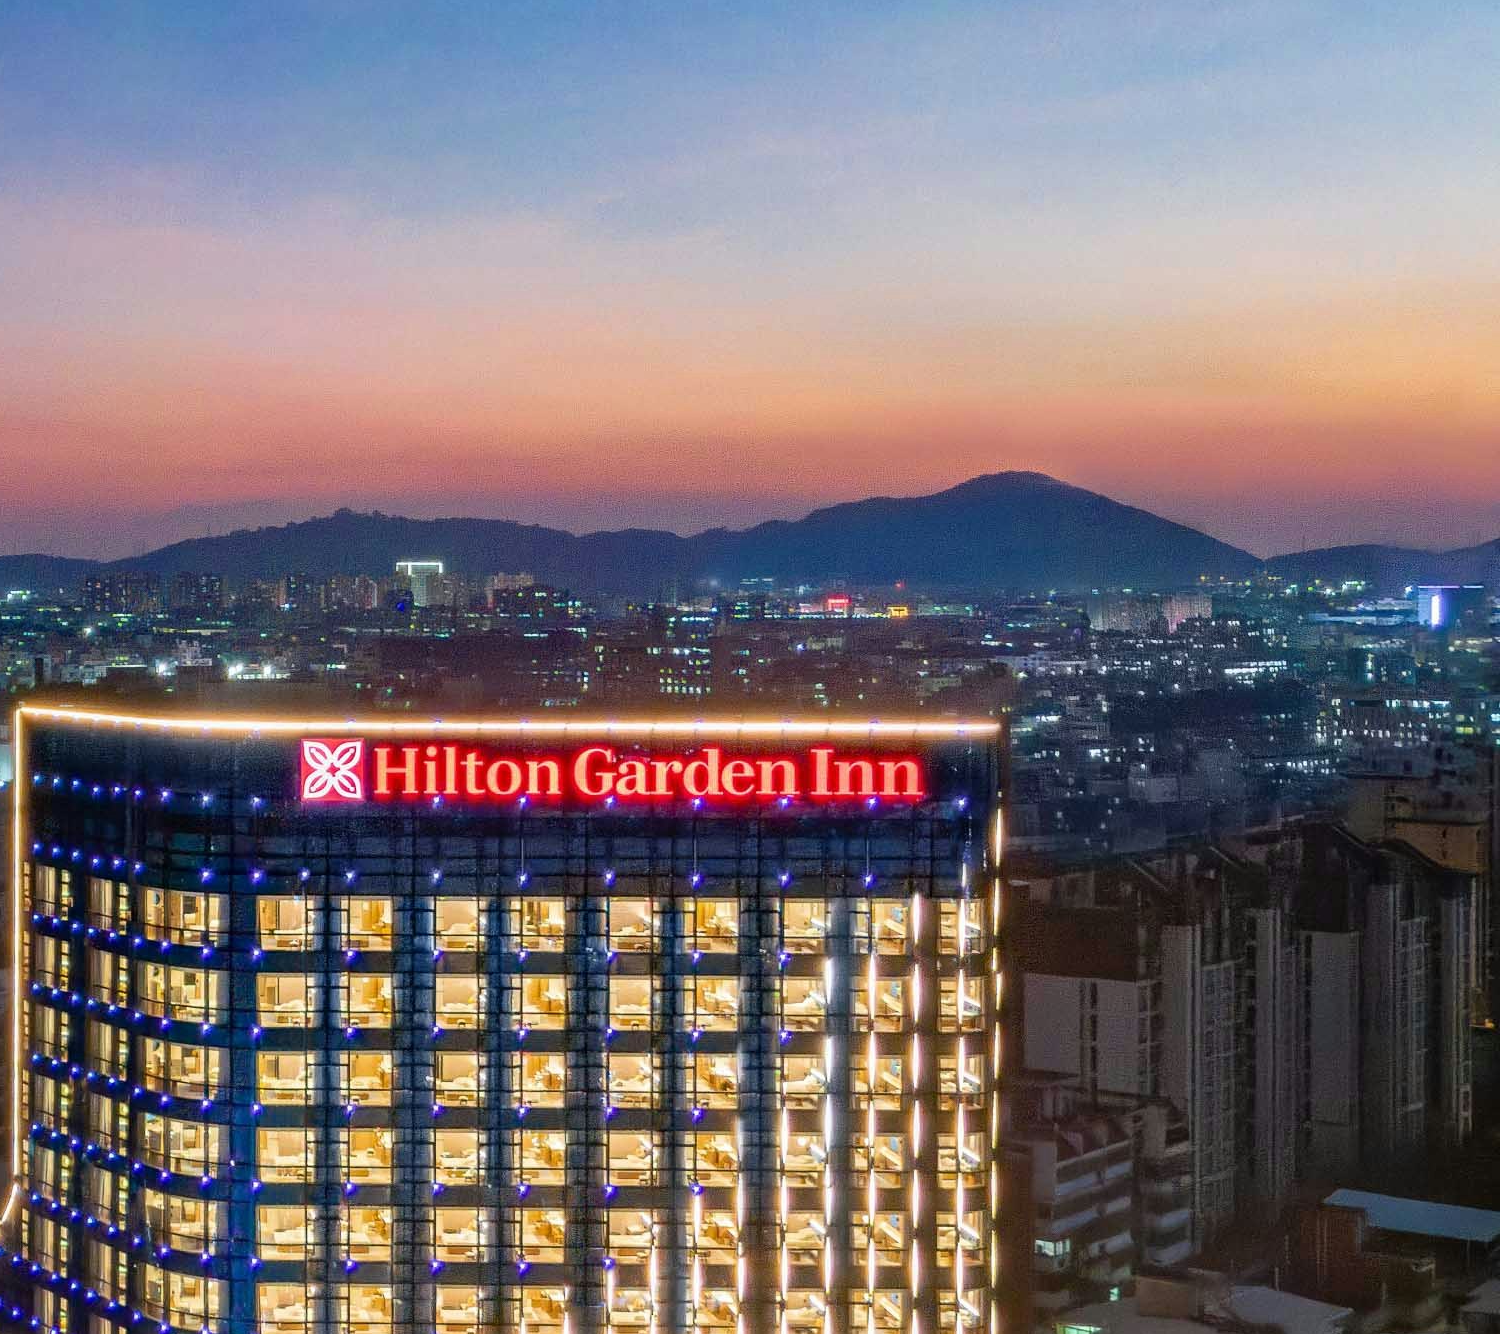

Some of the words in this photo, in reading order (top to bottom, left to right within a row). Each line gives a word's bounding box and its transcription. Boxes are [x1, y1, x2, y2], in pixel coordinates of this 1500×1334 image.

[374, 746, 561, 795] Hilton
[574, 747, 800, 796] Garden
[810, 748, 924, 795] Inn
